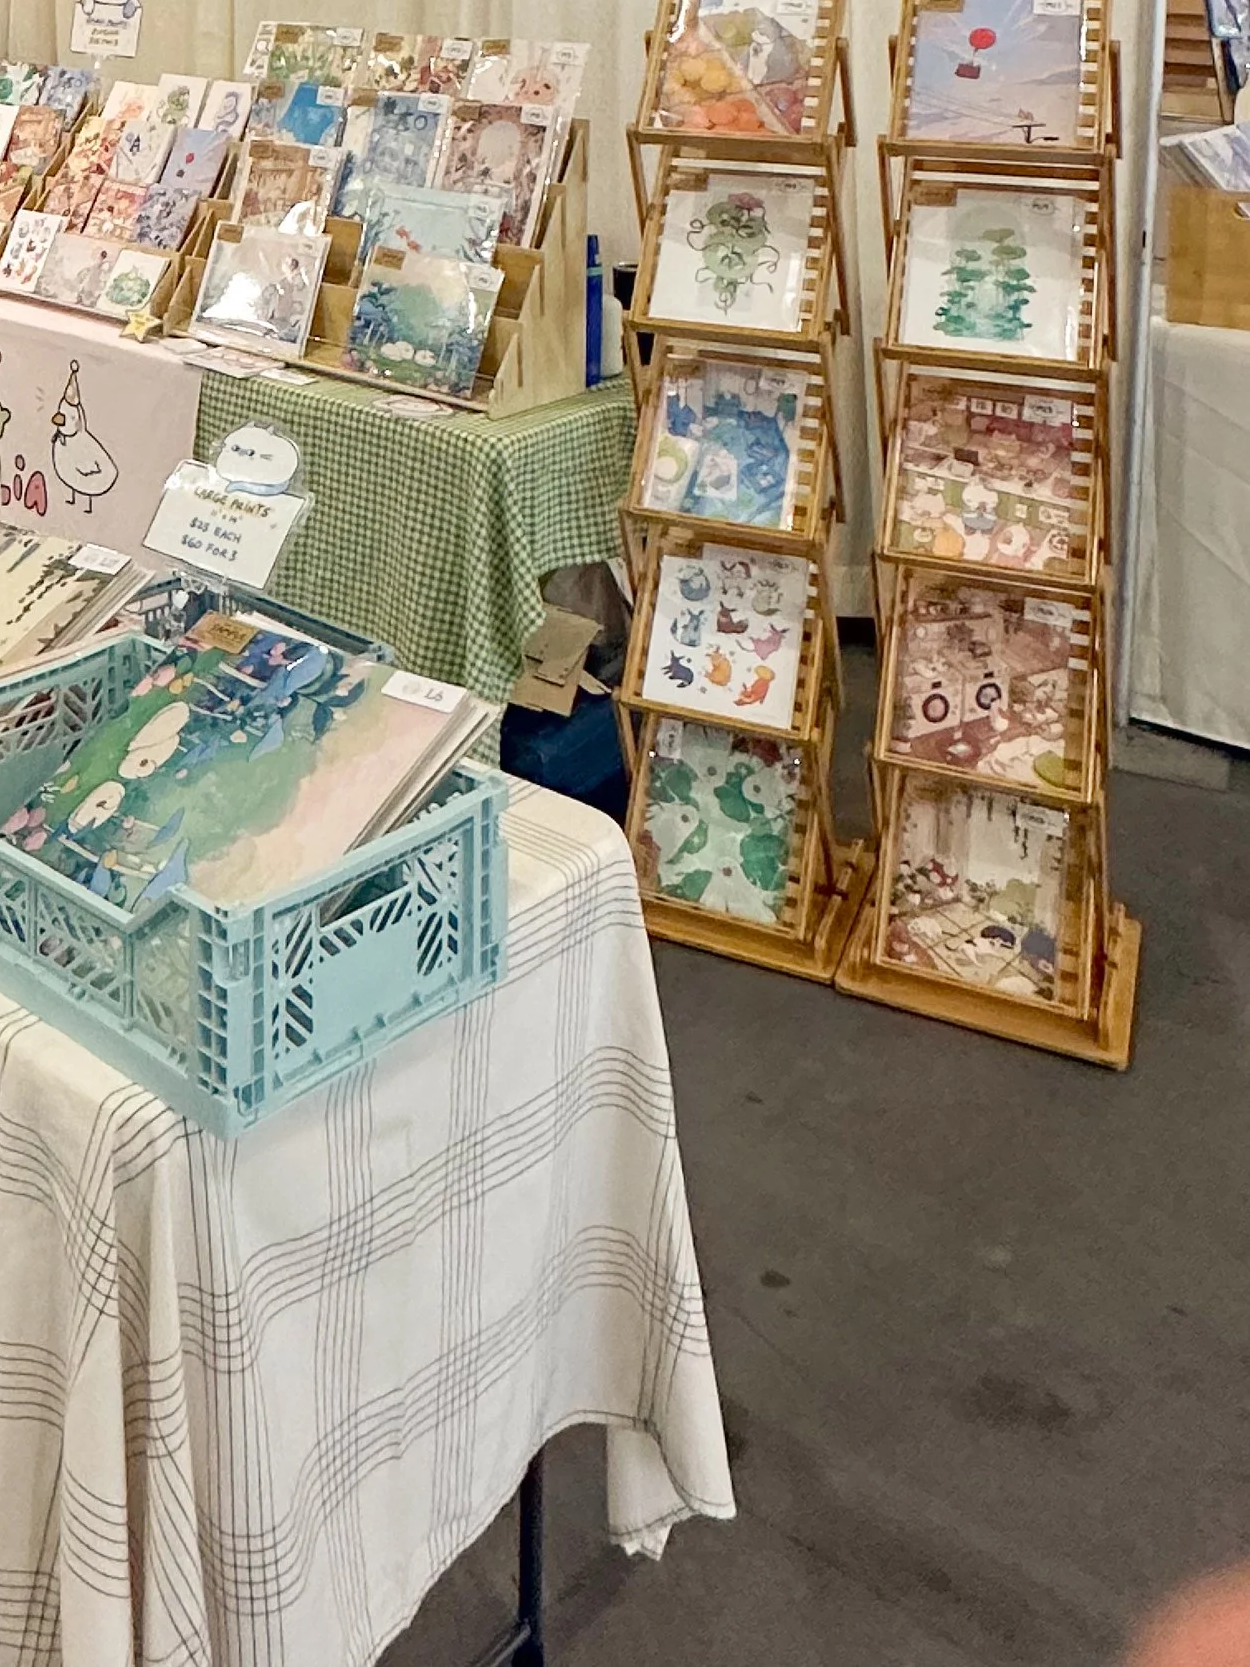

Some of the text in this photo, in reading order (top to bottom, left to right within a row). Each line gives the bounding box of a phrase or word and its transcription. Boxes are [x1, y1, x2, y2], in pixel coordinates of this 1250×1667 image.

[193, 485, 271, 518] LARGE PRINTS
[180, 534, 239, 563] $60 FOR 3
[213, 525, 242, 545] EACH
